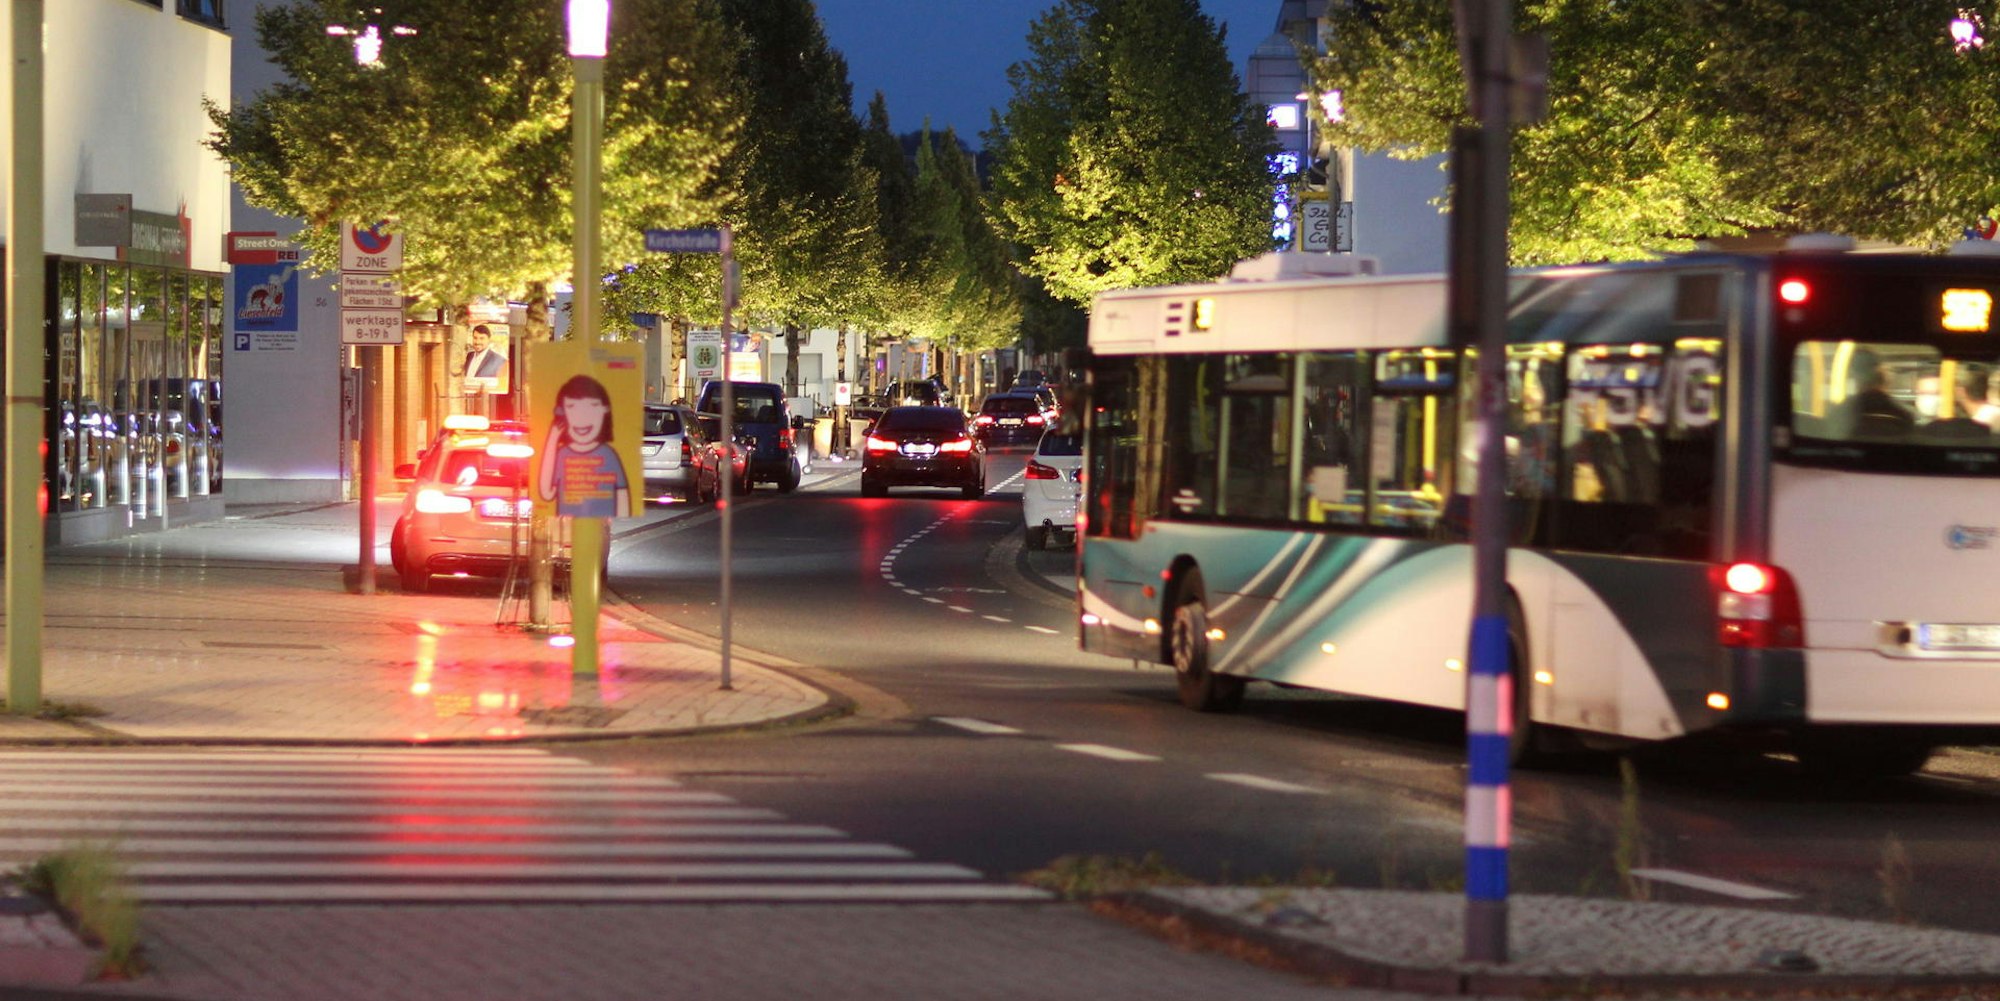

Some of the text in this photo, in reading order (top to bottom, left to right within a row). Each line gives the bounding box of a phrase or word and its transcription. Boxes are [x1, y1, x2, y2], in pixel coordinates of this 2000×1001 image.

[238, 239, 289, 248] Street One
[648, 233, 718, 249] Kirchstraße
[1308, 231, 1344, 244] Caé
[356, 256, 388, 268] ZONE
[345, 315, 399, 328] werktags
